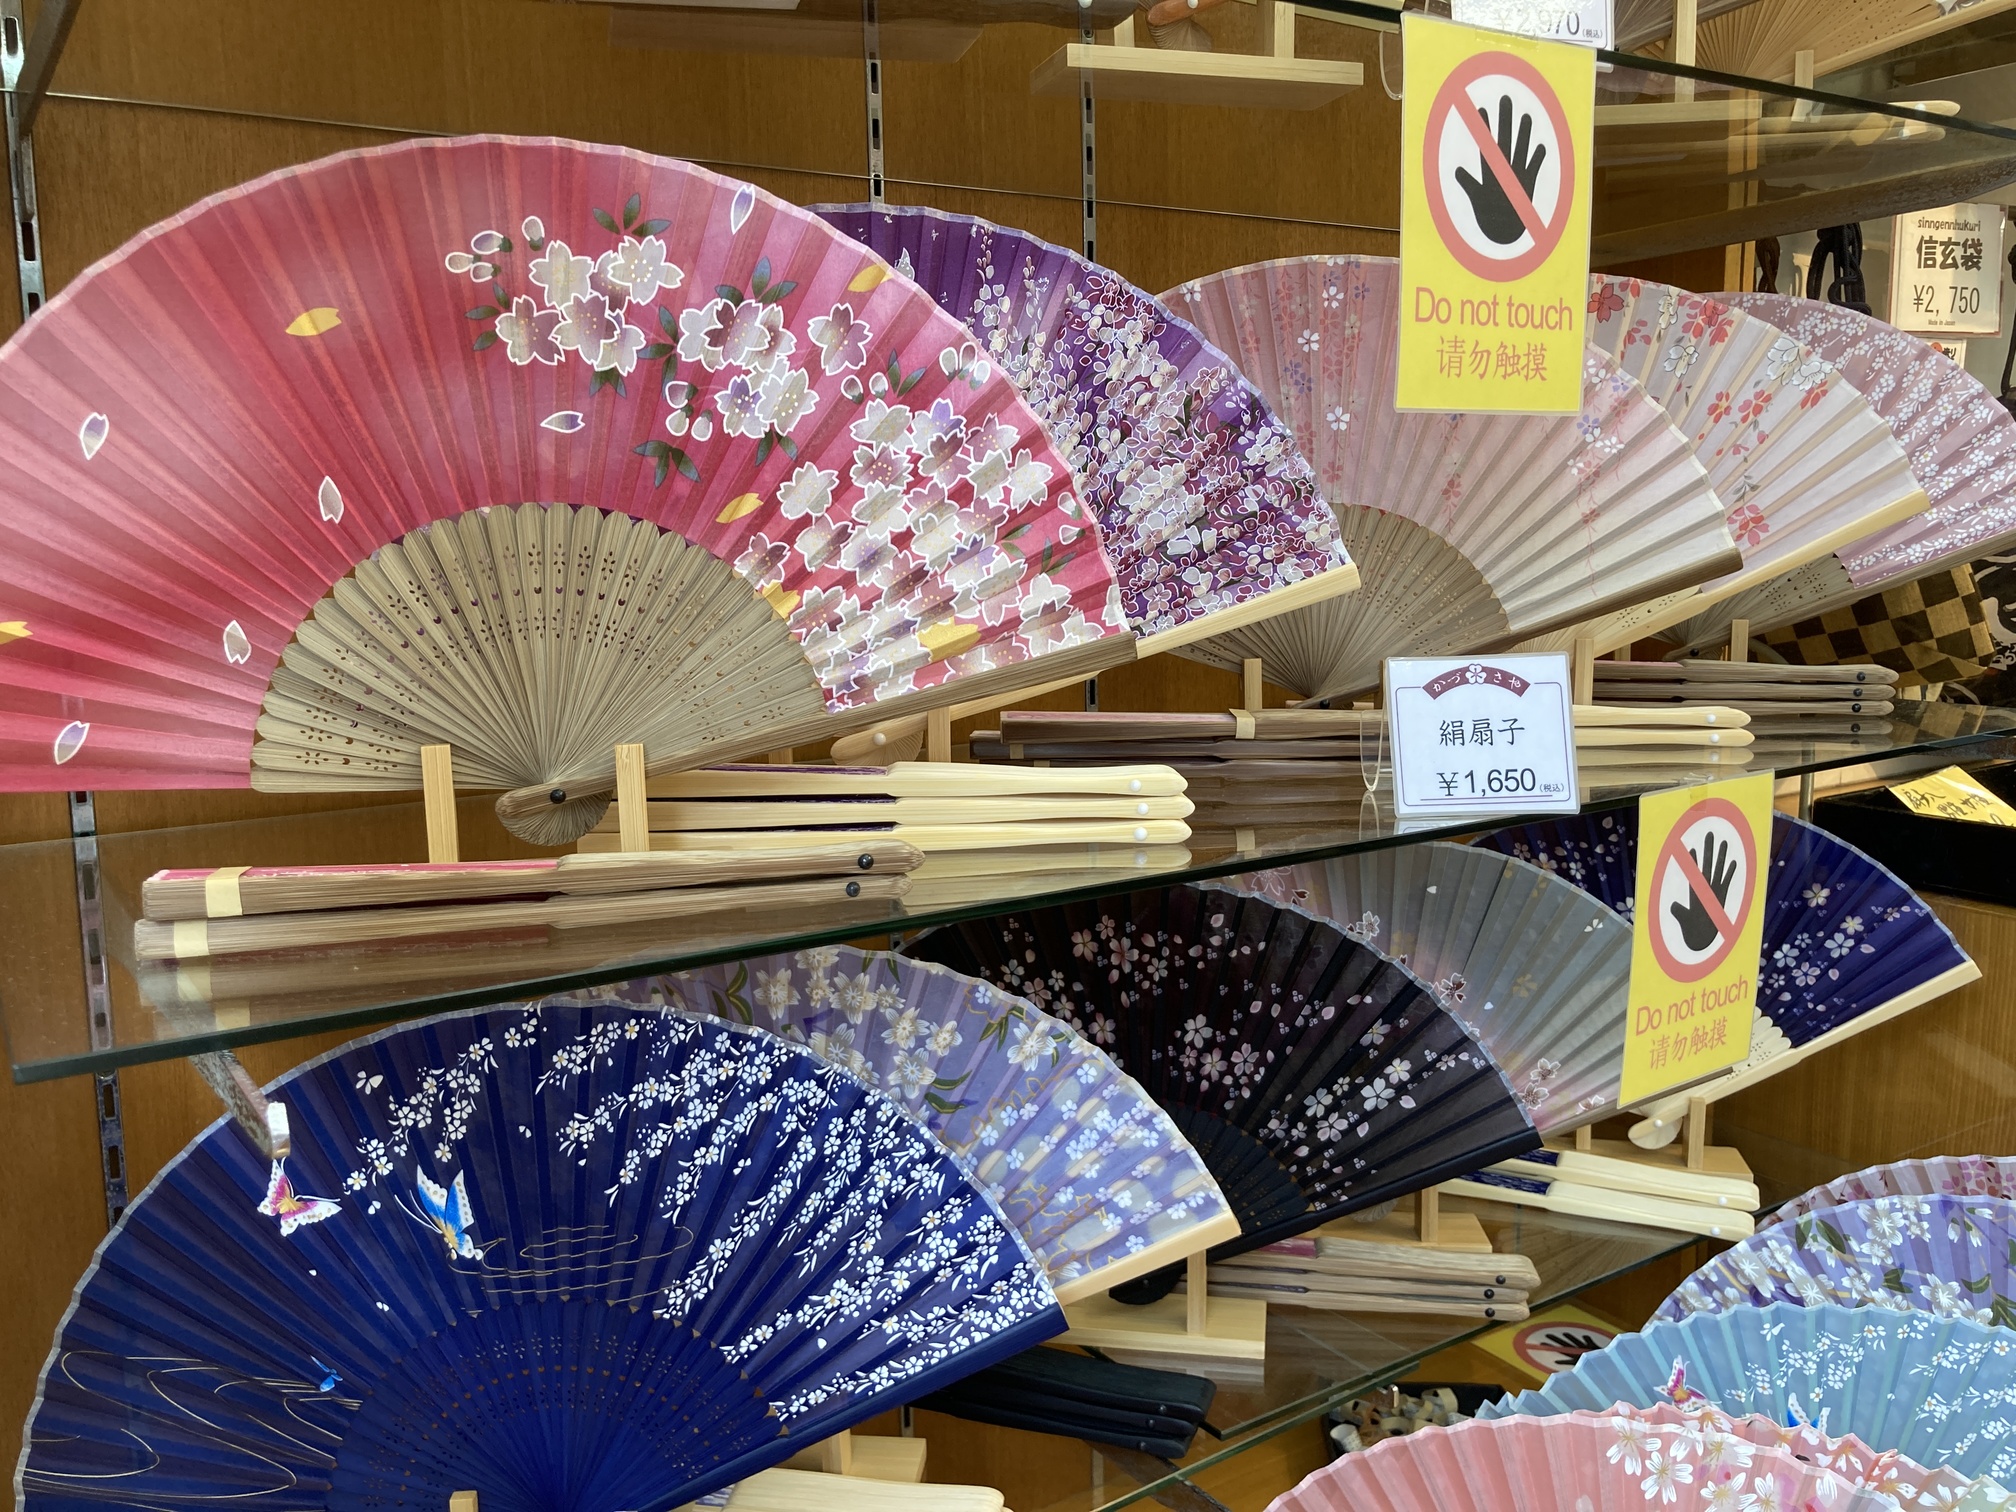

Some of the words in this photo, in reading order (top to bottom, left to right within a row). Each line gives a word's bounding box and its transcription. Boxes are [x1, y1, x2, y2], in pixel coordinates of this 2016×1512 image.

[1917, 217, 1981, 232] sinngennhukuri
[1916, 235, 1983, 271] 信玄袋
[1415, 286, 1452, 324] Do
[1460, 293, 1499, 327] not
[1506, 294, 1573, 331] touch
[1436, 335, 1548, 382] 请勿触摸
[1439, 718, 1525, 746] 絹扇子
[1539, 783, 1565, 793] (税込)
[1636, 1006, 1662, 1036] Do
[1667, 990, 1697, 1025] not
[1701, 974, 1749, 1013] touch
[1650, 1016, 1728, 1070] 请勿触摸
